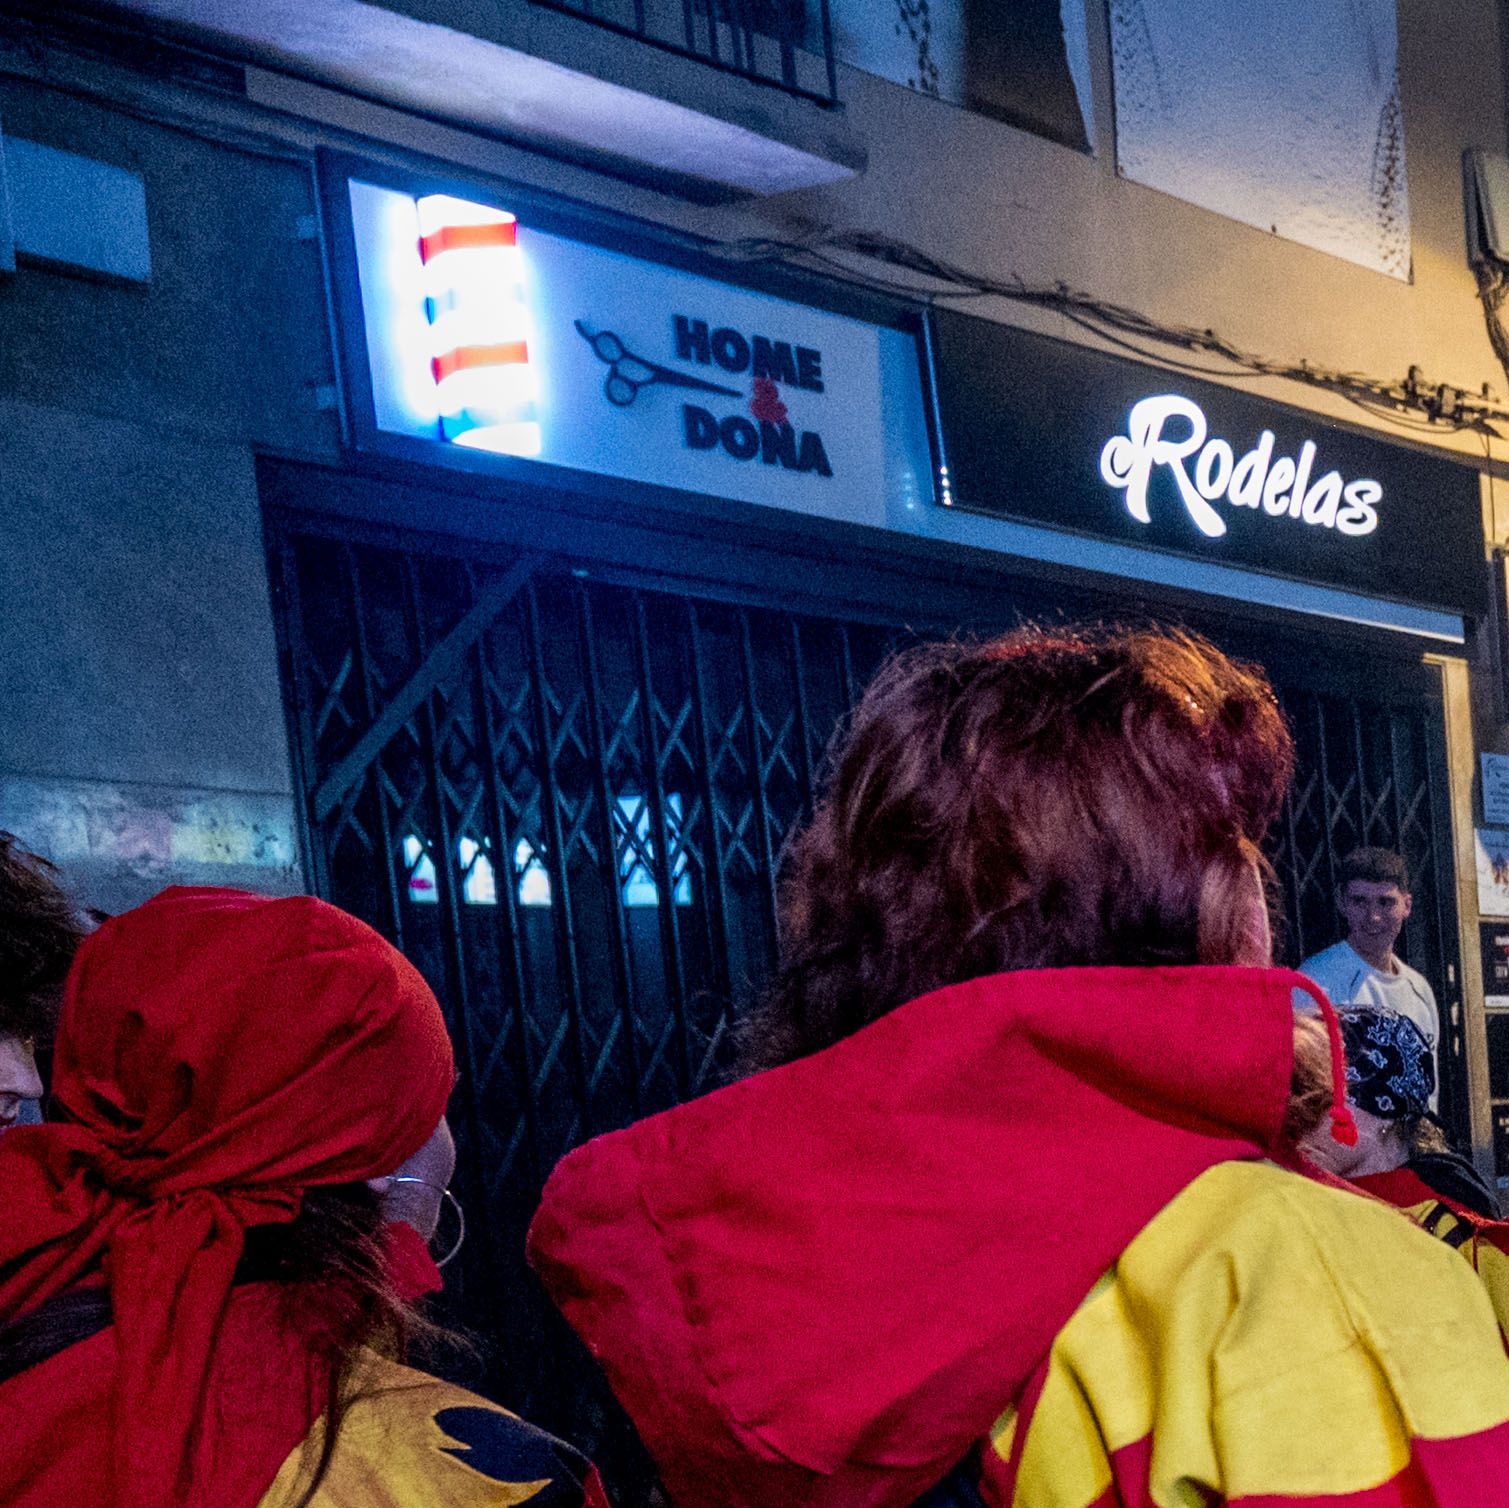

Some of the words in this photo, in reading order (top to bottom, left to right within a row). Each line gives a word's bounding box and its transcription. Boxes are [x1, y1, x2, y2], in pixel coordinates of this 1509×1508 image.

[672, 313, 825, 393] HOME
[681, 403, 834, 477] DONA
[1100, 394, 1384, 538] Rodelas
